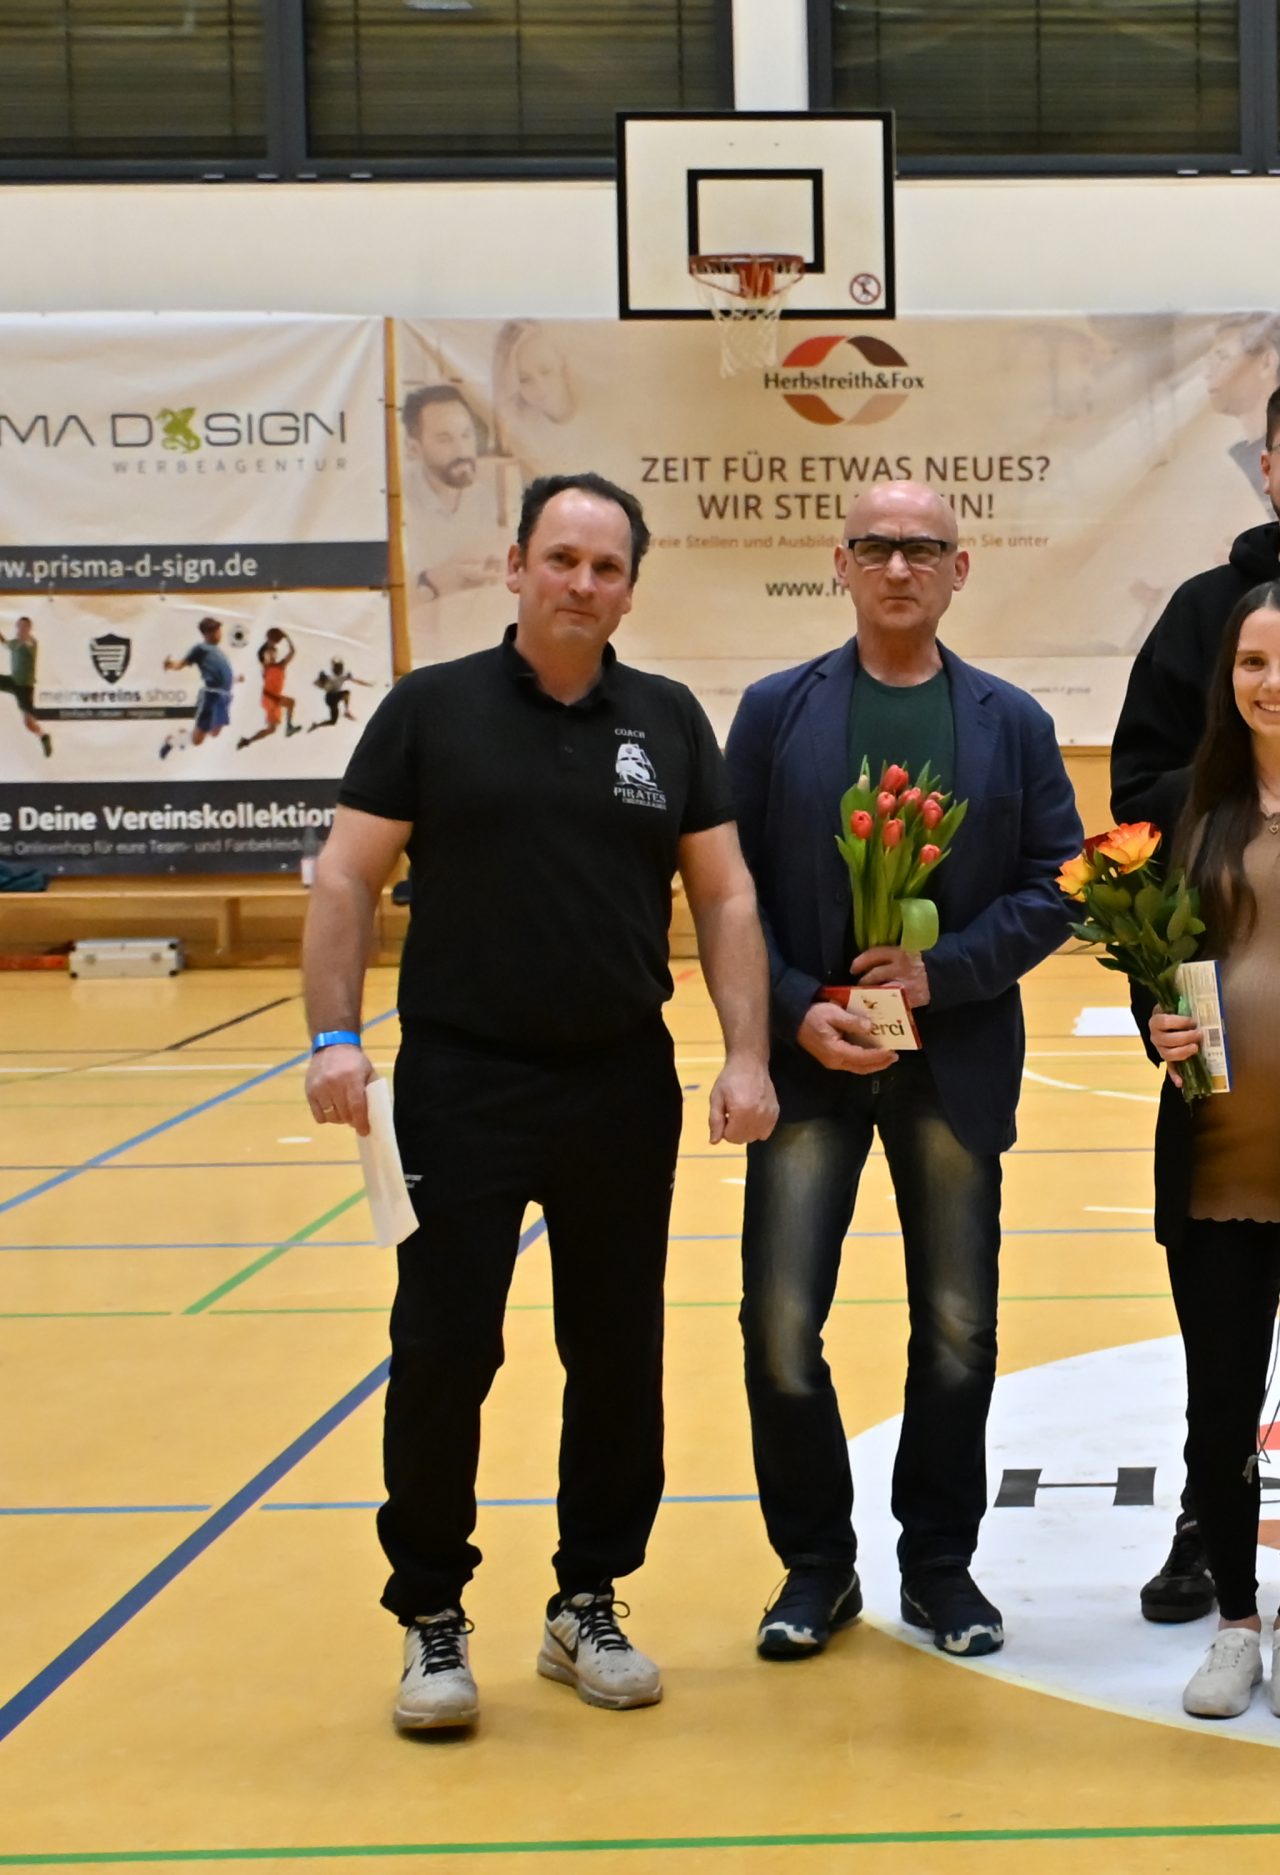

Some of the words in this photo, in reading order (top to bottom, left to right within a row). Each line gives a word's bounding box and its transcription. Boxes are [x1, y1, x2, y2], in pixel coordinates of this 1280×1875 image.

[763, 370, 925, 390] Herbstreith&Fox
[112, 457, 347, 475] WERBEAGENTUR
[641, 457, 711, 483] ZEIT
[723, 450, 788, 483] FÜR
[801, 456, 912, 482] ETWAS
[925, 455, 1051, 482] NEUES?
[698, 494, 762, 519] WIR
[775, 494, 859, 520] STEL
[940, 494, 994, 519] IN!
[650, 536, 681, 548] reie
[686, 535, 739, 548] Stellen
[743, 535, 773, 548] und
[981, 534, 1003, 548] Sie
[1008, 536, 1049, 548] unter
[0, 553, 258, 583] w.prisma-d-sign.de
[614, 728, 646, 739] COACH
[613, 786, 667, 804] PIRATES
[18, 804, 98, 831] Deine
[102, 802, 336, 831] Vereinskollektion
[194, 839, 222, 853] und
[868, 1019, 905, 1037] erci
